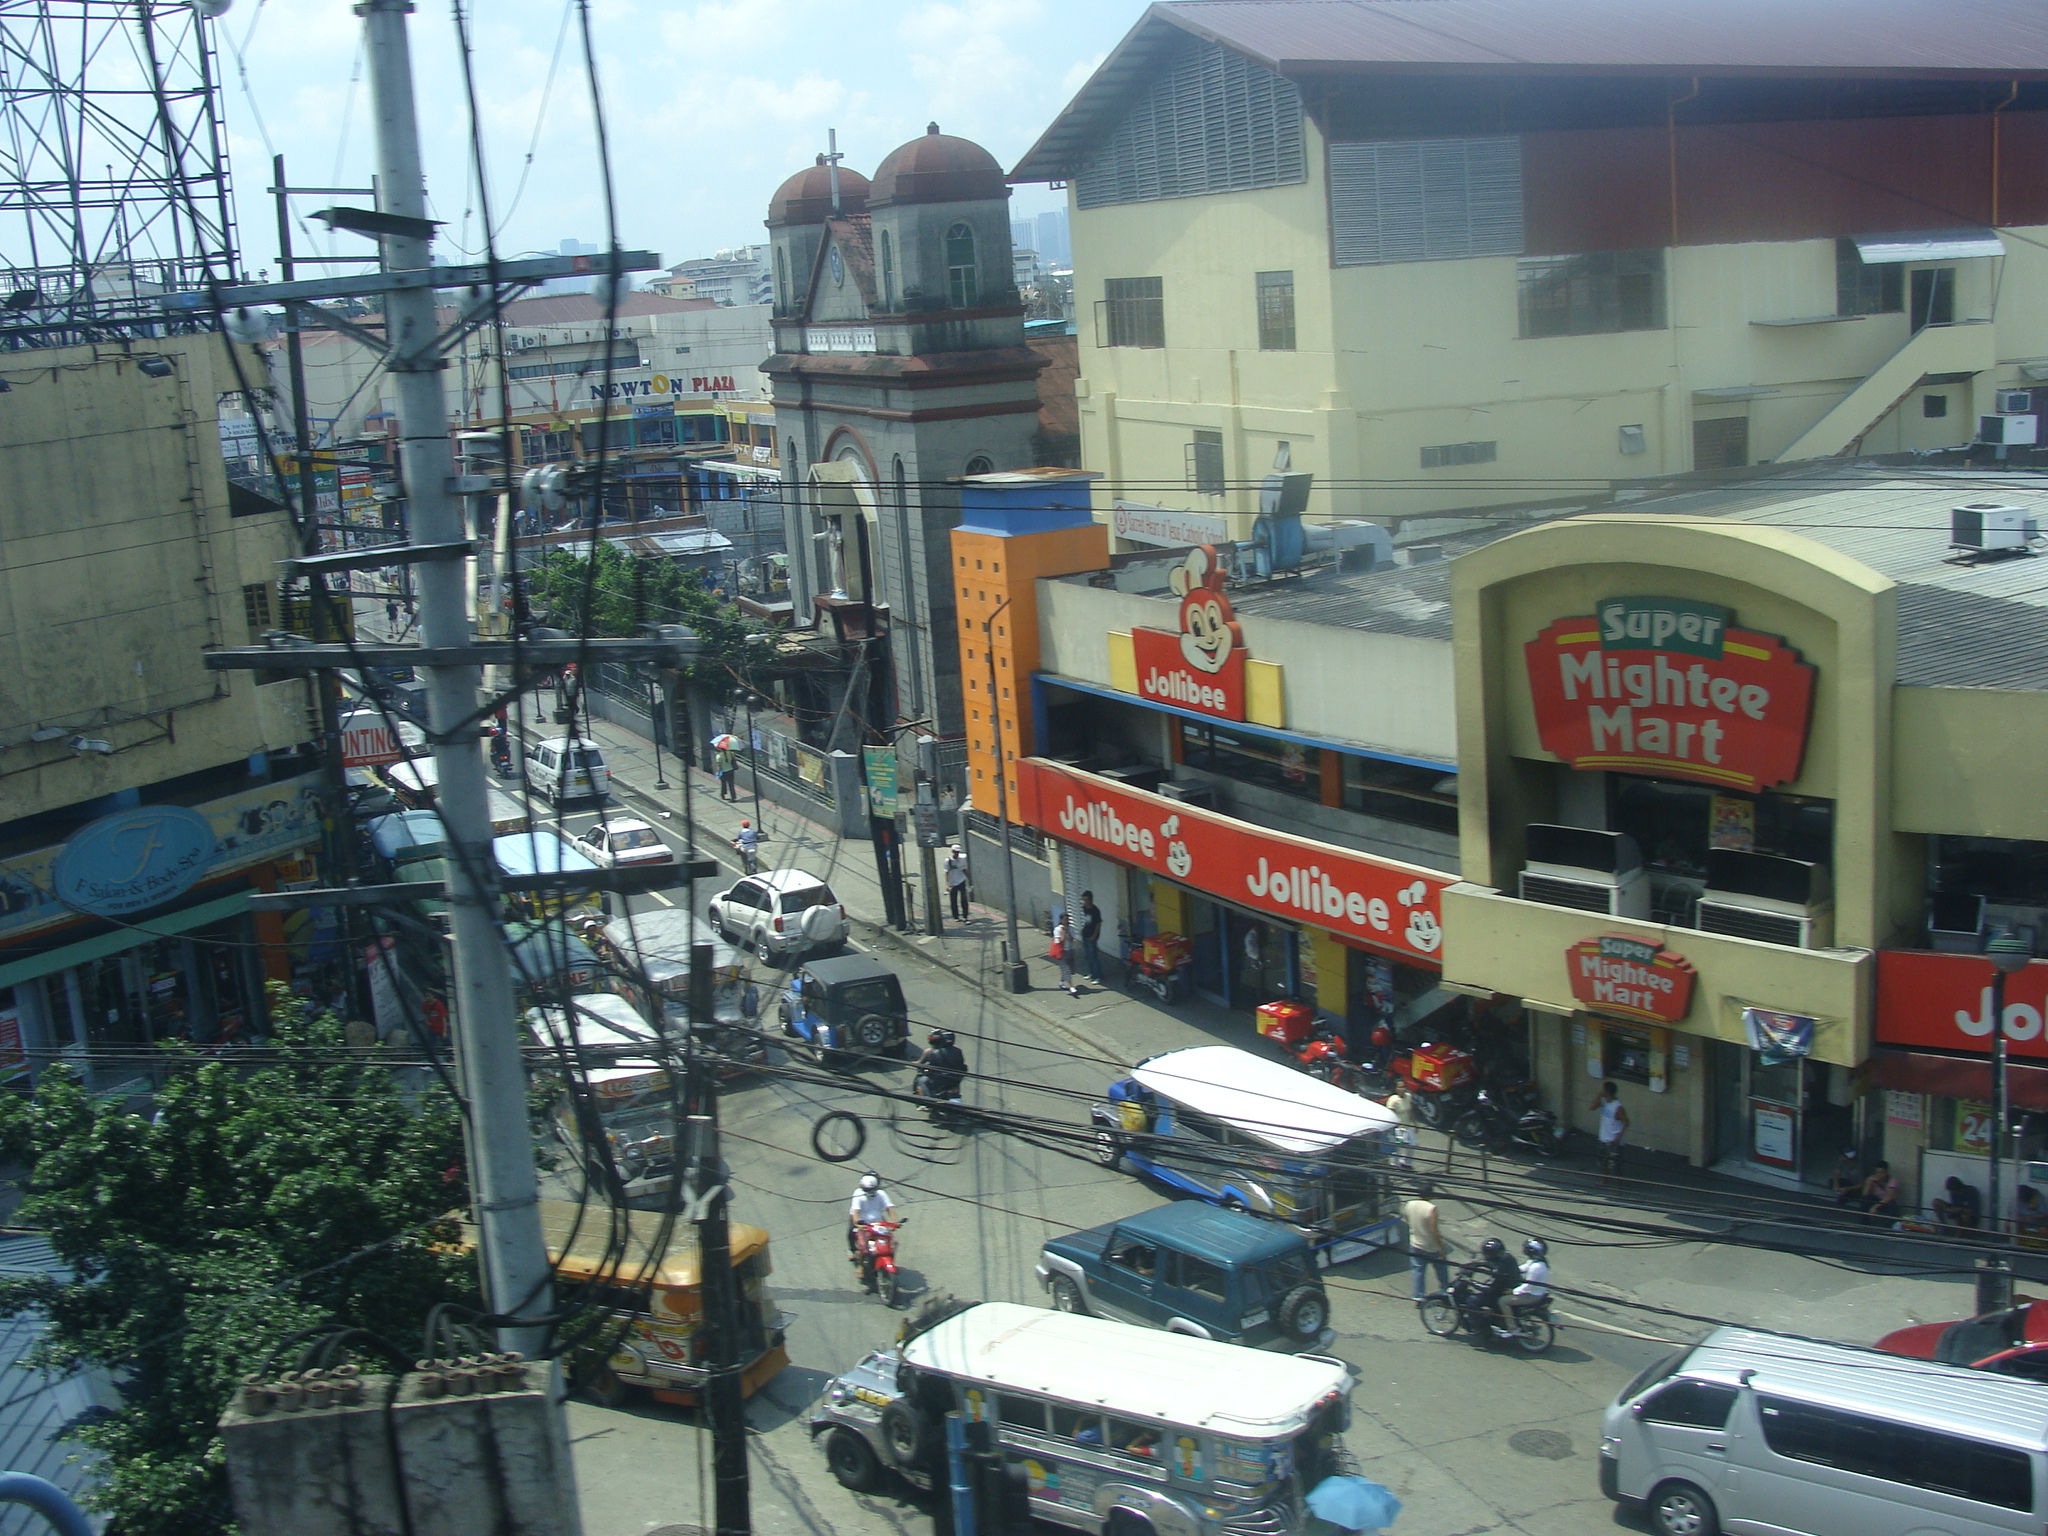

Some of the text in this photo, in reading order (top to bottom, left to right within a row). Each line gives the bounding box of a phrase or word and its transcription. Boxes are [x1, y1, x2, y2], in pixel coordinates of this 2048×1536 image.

[590, 374, 736, 400] NEWTON PLAZA
[1602, 603, 1722, 647] Super
[1144, 667, 1226, 710] Jollibee
[1558, 650, 1770, 721] Mightee
[1588, 705, 1724, 764] Mart
[1059, 795, 1155, 858] Jollibee
[89, 881, 126, 898] Salon
[177, 847, 201, 871] Spa
[1246, 857, 1390, 931] Jollibee
[1600, 939, 1653, 960] Super
[1581, 955, 1674, 994] Mightee
[1594, 980, 1654, 1011] Mart
[1963, 1115, 1991, 1142] 24
